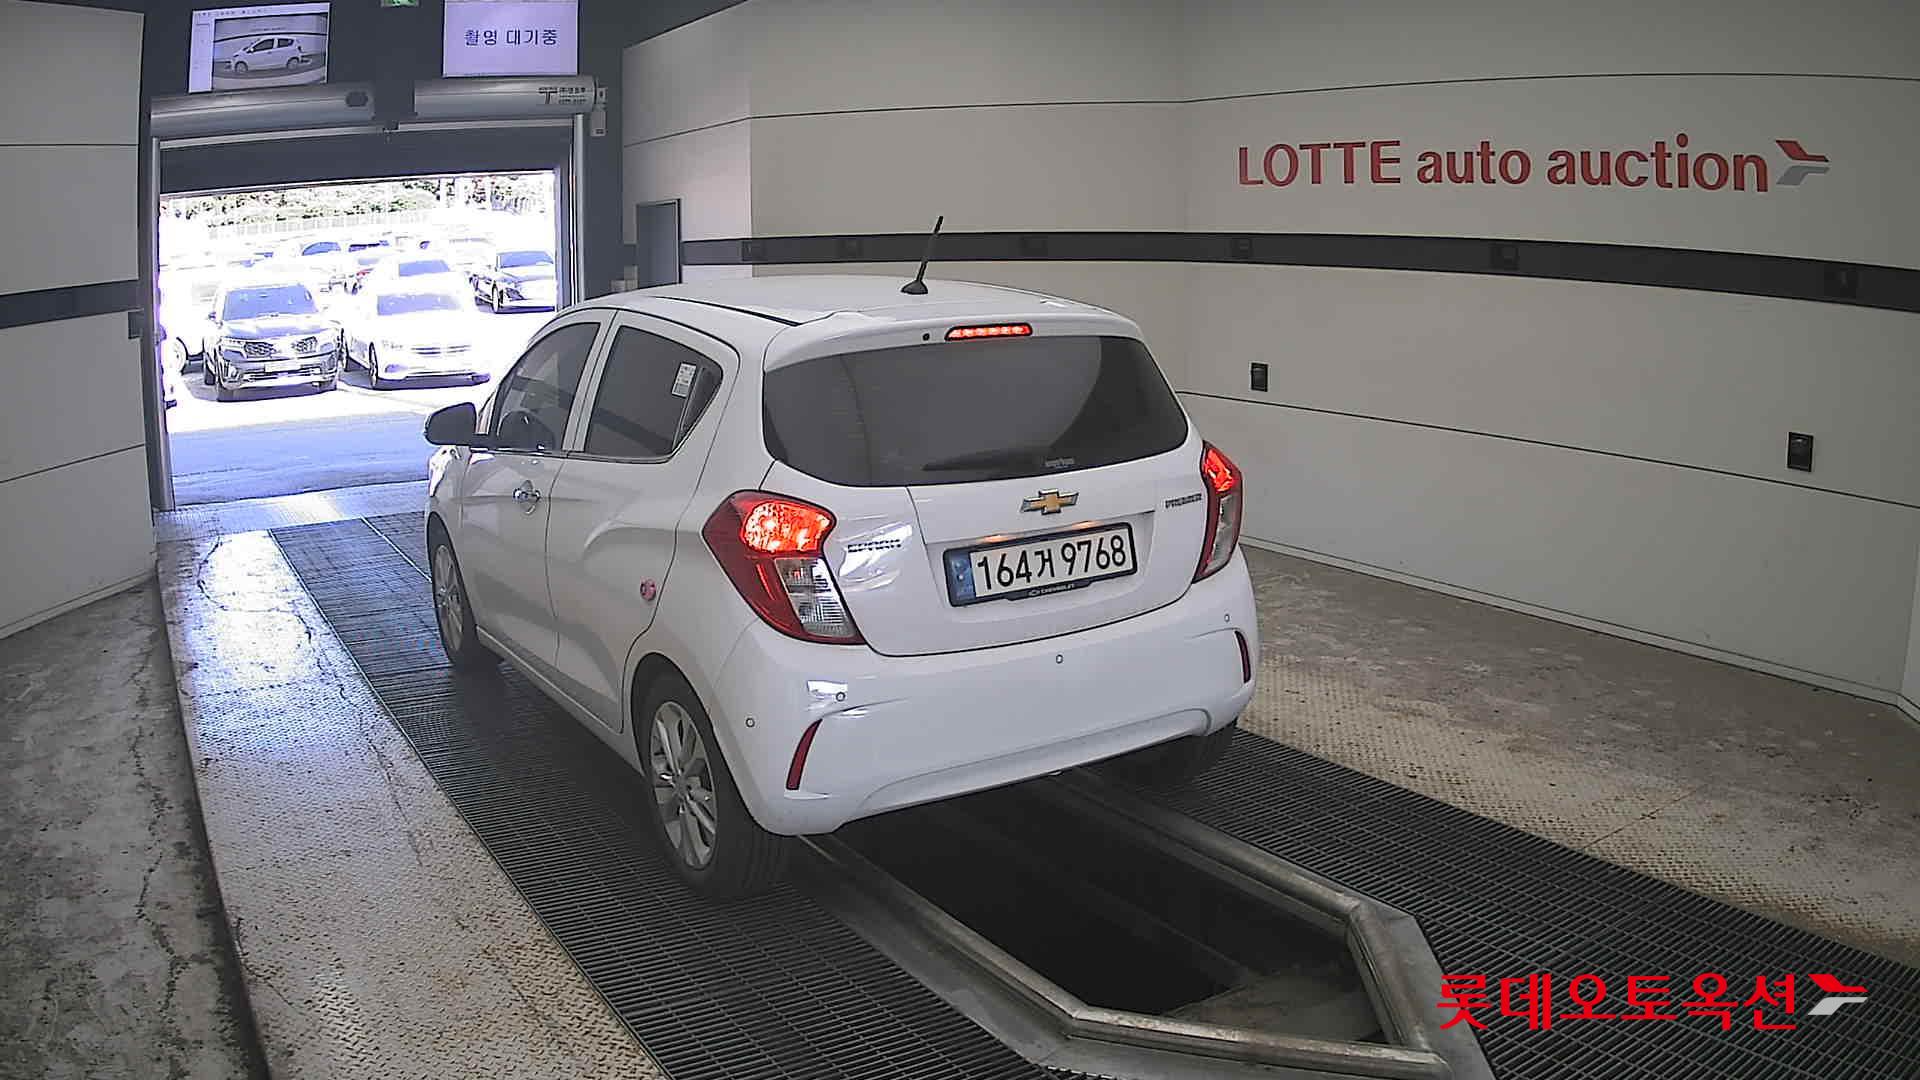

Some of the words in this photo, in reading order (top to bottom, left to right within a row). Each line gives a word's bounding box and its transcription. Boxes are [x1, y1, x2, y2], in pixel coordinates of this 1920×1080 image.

[506, 28, 557, 46] 대기중
[1239, 139, 1400, 186] LOTTE
[1416, 141, 1531, 185] auto
[1547, 133, 1769, 192] auction
[977, 549, 1055, 590] 164거
[1060, 534, 1126, 576] 9768
